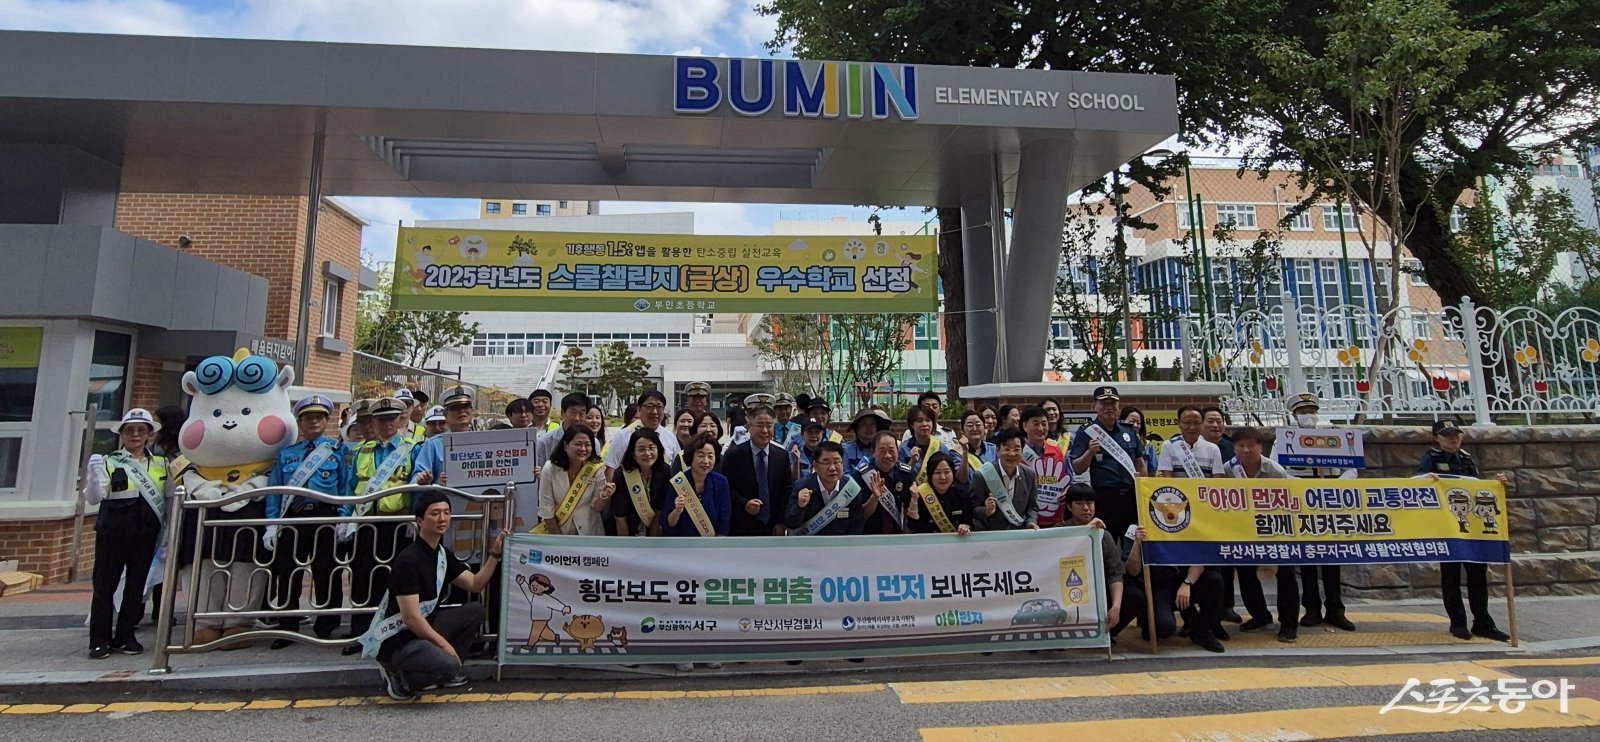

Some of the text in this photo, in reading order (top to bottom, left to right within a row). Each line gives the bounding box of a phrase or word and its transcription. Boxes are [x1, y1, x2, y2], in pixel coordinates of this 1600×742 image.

[673, 55, 1145, 119] BUMIN ELEMENTARY SCHOOL
[636, 244, 657, 258] 앱을
[661, 246, 692, 258] 활용한
[696, 247, 737, 259] 탄소중립
[742, 247, 782, 259] 실천교육
[424, 263, 913, 293] 2025학년도 스쿨챌린지(금상) 우수학교 선정
[654, 300, 717, 310] 부민초등학교
[450, 448, 528, 462] 횡단보도 앞 우선멈춤
[461, 458, 520, 470] 아이들을 안전을
[467, 467, 514, 479] 지켜주세요!!
[1198, 486, 1440, 511] 『아이 먼저』 어린이 교통안전
[1254, 512, 1392, 537] 함께 지켜주세요
[1219, 541, 1450, 560] 부산서부경찰서 충무지구대 생활안전협의회
[544, 554, 610, 567] 아이먼저 캠페인
[578, 570, 1041, 606] 횡단보도 앞 일단 멈춤 아이 먼저 보내주세요.
[692, 620, 718, 631] 서구
[753, 618, 823, 631] 부산서부경찰서
[935, 609, 984, 627] 아이먼저
